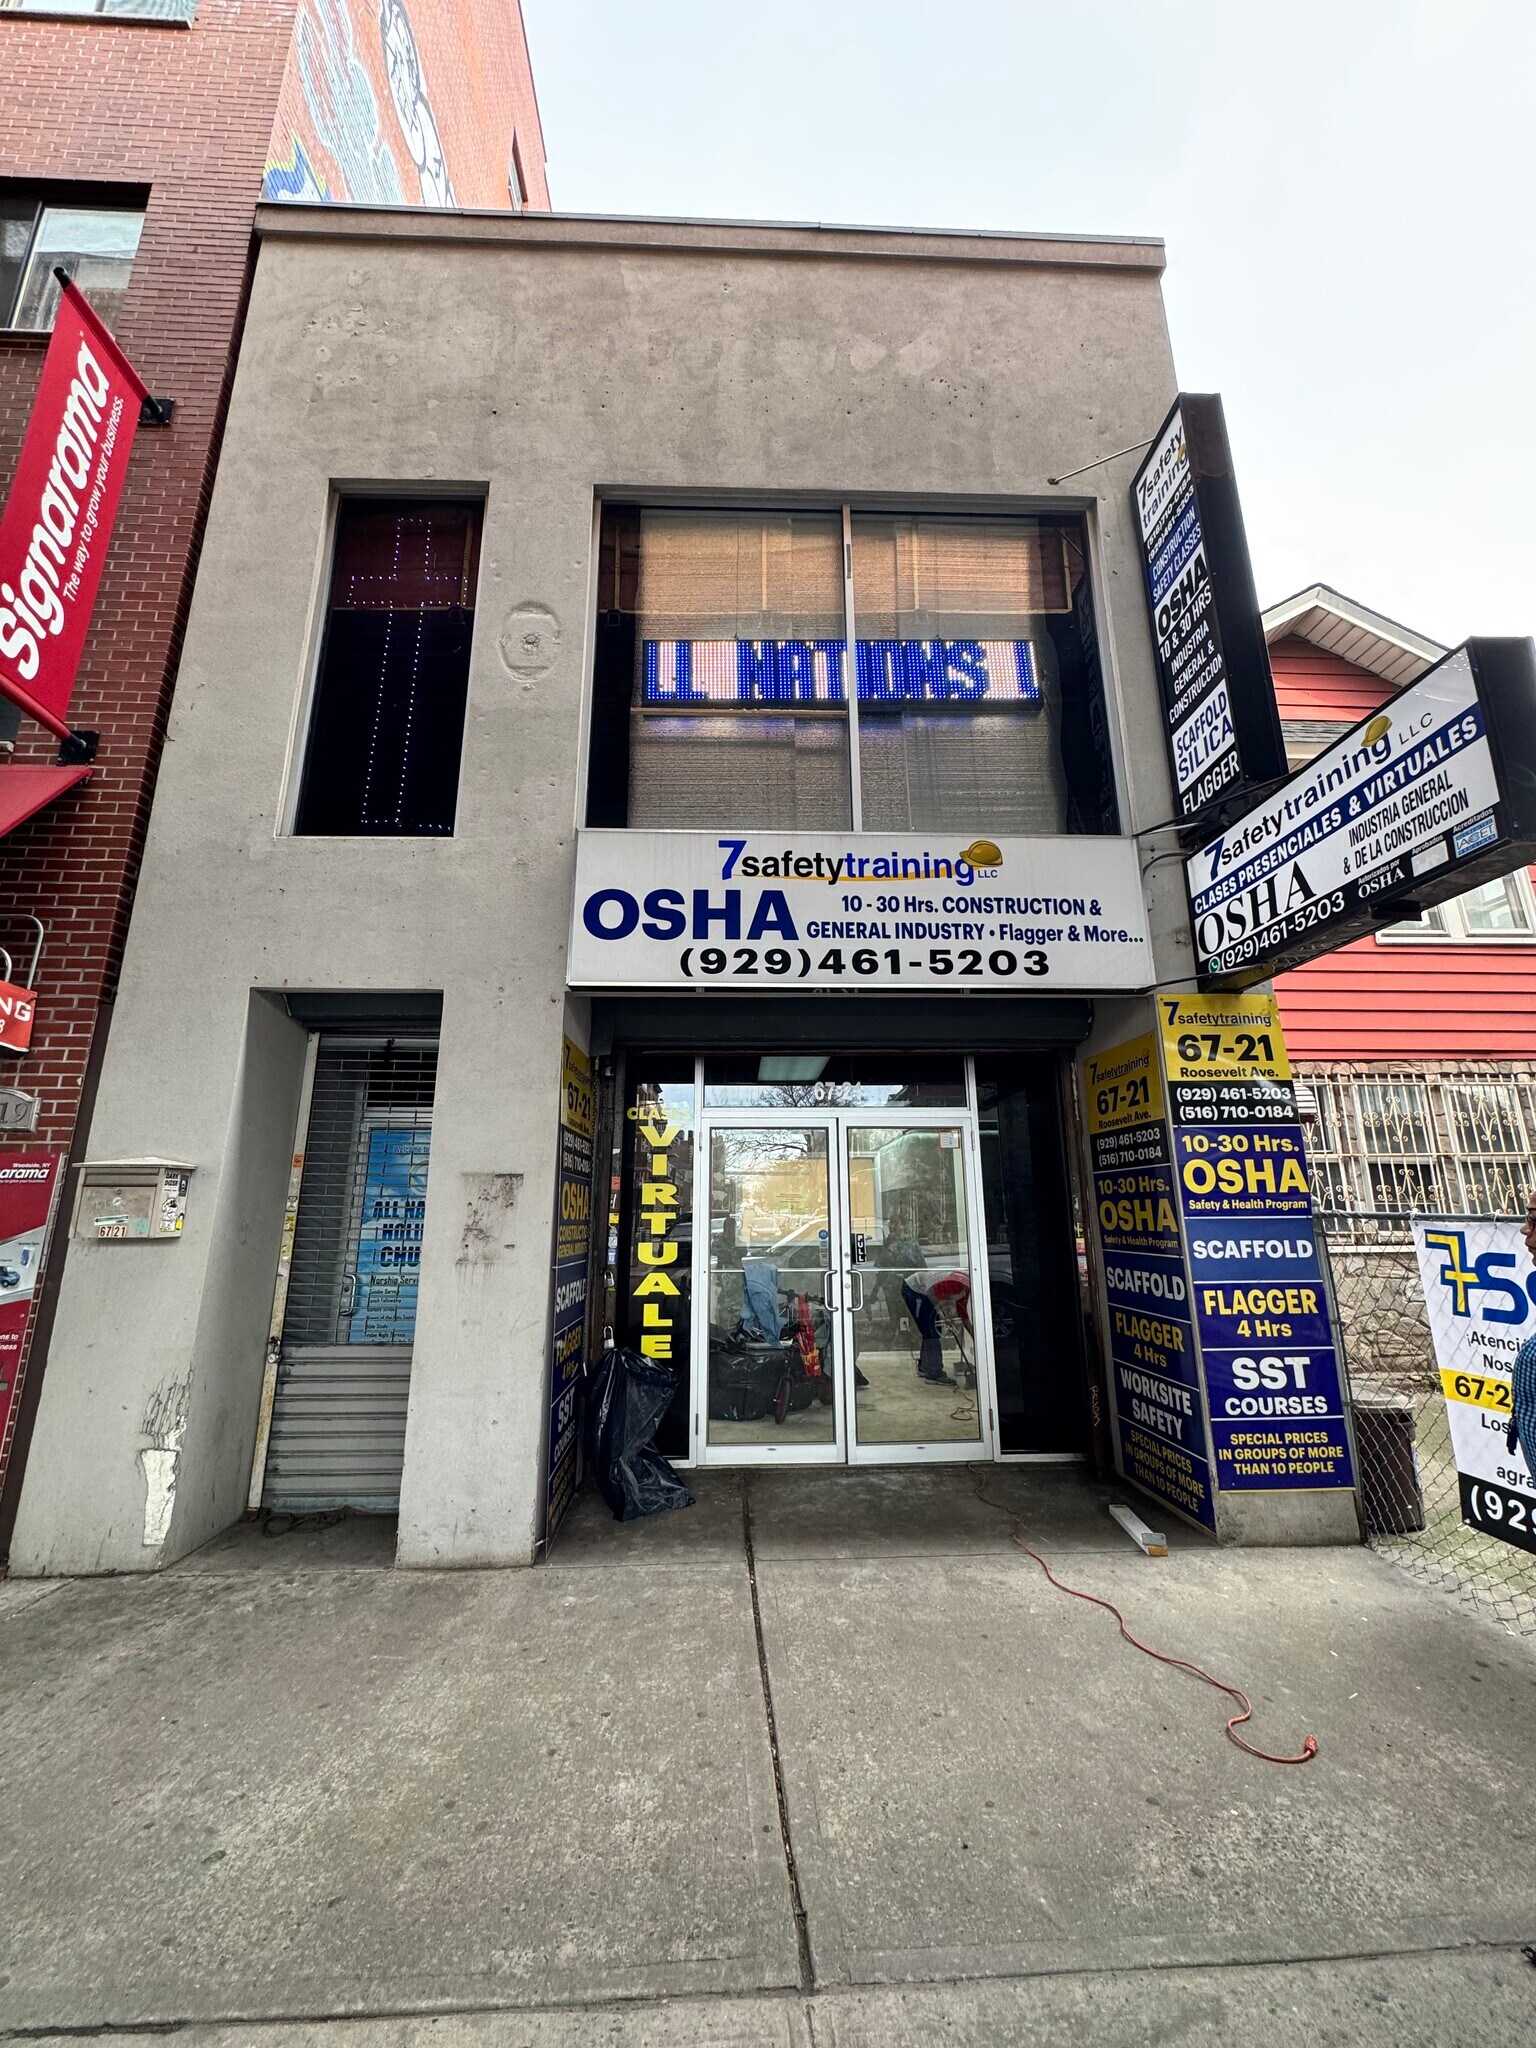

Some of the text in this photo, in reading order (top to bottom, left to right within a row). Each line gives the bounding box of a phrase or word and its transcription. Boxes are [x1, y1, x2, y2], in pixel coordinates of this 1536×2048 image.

[1138, 425, 1183, 512] 7safety
[63, 396, 125, 601] The way to grow your business.
[1143, 455, 1188, 529] training
[0, 340, 110, 681] Signarama
[1152, 506, 1196, 582] CONSTRUCTION
[1153, 521, 1202, 603] SAFETY CLASSES
[1158, 552, 1207, 638] OSHA
[1160, 584, 1212, 664] 10 & 30 HRS
[1171, 619, 1210, 676] INDUSTRIA
[1174, 639, 1215, 695] GENERAL &
[1169, 653, 1223, 724] CONSTRUCCION
[1177, 691, 1227, 759] SCAFFOLD
[1398, 712, 1433, 745] LLC
[1178, 715, 1234, 782] SILICA
[1182, 750, 1240, 815] FLAGGER
[1194, 715, 1477, 914] CLASES PRESENCIALES & VIRTUALES
[1349, 801, 1401, 848] INDUSTRIA
[1401, 769, 1453, 816] GENERAL
[1452, 808, 1494, 833] Acreditados
[1343, 857, 1351, 876] &
[1355, 846, 1369, 869] DE
[1370, 838, 1383, 861] LA
[1384, 787, 1470, 851] CONSTRUCCION
[1411, 834, 1444, 856] Aprobados
[718, 839, 998, 886] 7safetytraining LLC
[1358, 858, 1401, 885] Autorizados por
[1358, 867, 1406, 899] OSHA
[583, 889, 799, 941] OSHA
[842, 895, 1103, 917] 10 30 Hrs. CONSTRUCTION &
[1198, 861, 1317, 955] OSHA
[806, 921, 1144, 946] GENERAL INDUSTRY Flagger & More...
[1221, 891, 1345, 972] (929)461-5203
[679, 948, 1051, 979] (929)461-5203
[1163, 1001, 1272, 1026] 7safetytraining
[1177, 1034, 1275, 1063] 67-21
[1180, 1067, 1279, 1078] Roosevelt Ave.
[568, 1081, 591, 1121] 67-21
[1097, 1076, 1150, 1115] 67-21
[1176, 1087, 1292, 1103] (929) 461-5203
[1098, 1110, 1151, 1130] Roosevelt Ave.
[1179, 1105, 1294, 1121] (516) 710-0184
[1097, 1127, 1160, 1150] (929) 461-5203
[1182, 1134, 1300, 1153] 10-30 Hrs.
[0, 1168, 49, 1179] arama
[1099, 1145, 1162, 1168] (516) 710-0184
[1098, 1176, 1170, 1195] 10-30 Hrs.
[1183, 1158, 1309, 1194] OSHA
[373, 1201, 400, 1218] ALL
[562, 1181, 589, 1220] OSHA
[1100, 1198, 1179, 1233] OSHA
[1189, 1199, 1308, 1211] Safety & Health Program
[633, 1126, 681, 1371] VIRTUALE
[857, 1235, 865, 1262] PULL
[1104, 1235, 1178, 1249] Safety & Health Program
[1192, 1239, 1313, 1259] SCAFFOLD
[1106, 1266, 1185, 1301] SCAFFOLD
[1203, 1289, 1319, 1315] FLAGGER
[1115, 1312, 1185, 1353] FLAGGER
[1237, 1319, 1293, 1338] 4 Hrs
[1133, 1343, 1167, 1367] 4 Hrs
[1483, 1354, 1513, 1373] Nos
[1232, 1356, 1310, 1390] SST
[1120, 1367, 1193, 1416] WORKSITE
[1224, 1396, 1328, 1416] COURSES
[558, 1386, 575, 1433] SST
[1132, 1398, 1182, 1441] SAFETY
[1481, 1413, 1510, 1434] Los
[1131, 1429, 1192, 1474] SPECIAL PRICES
[1218, 1446, 1344, 1460] IN GROUPS OF MORE
[1230, 1432, 1328, 1445] SPECIAL PRICES
[1125, 1442, 1205, 1499] IN GROUPS OF MORE
[1233, 1461, 1335, 1475] THAN 10 PEOPLE
[1134, 1462, 1200, 1513] THAN 10 PEOPLE
